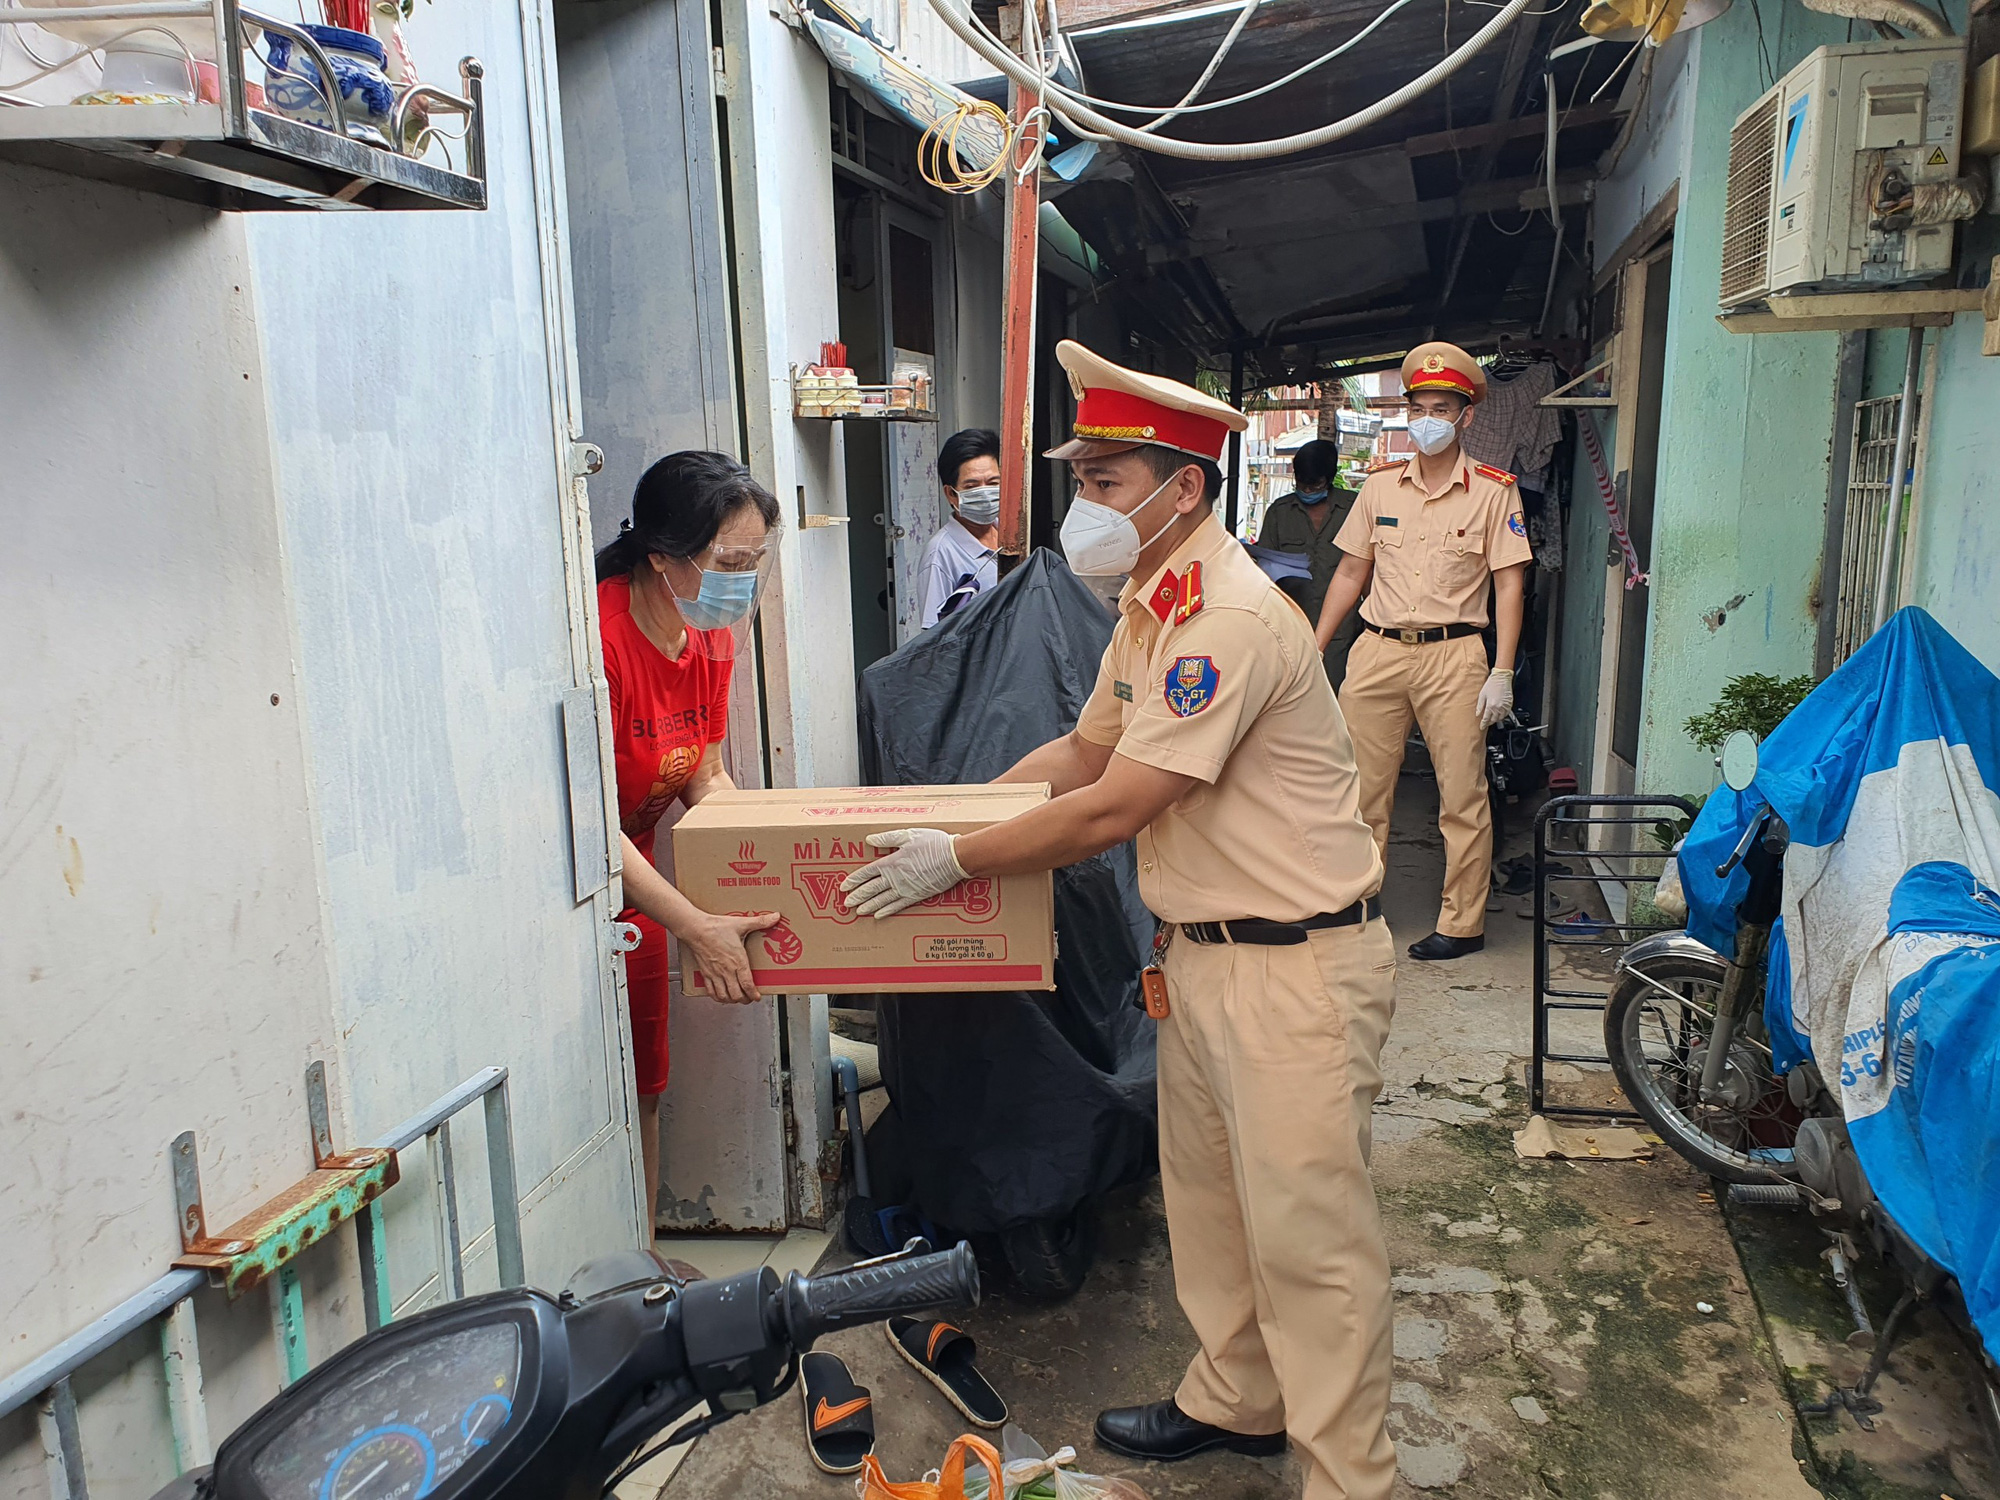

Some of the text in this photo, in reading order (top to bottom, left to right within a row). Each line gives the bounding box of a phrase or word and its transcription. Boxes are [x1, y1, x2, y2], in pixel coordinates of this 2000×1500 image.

[1169, 688, 1206, 699] CS GT
[632, 704, 709, 738] BURBERR
[794, 838, 820, 860] MÌ
[829, 837, 864, 859] ĂN
[717, 876, 781, 887] THIEN HUONG FOOD
[986, 951, 994, 959] g)
